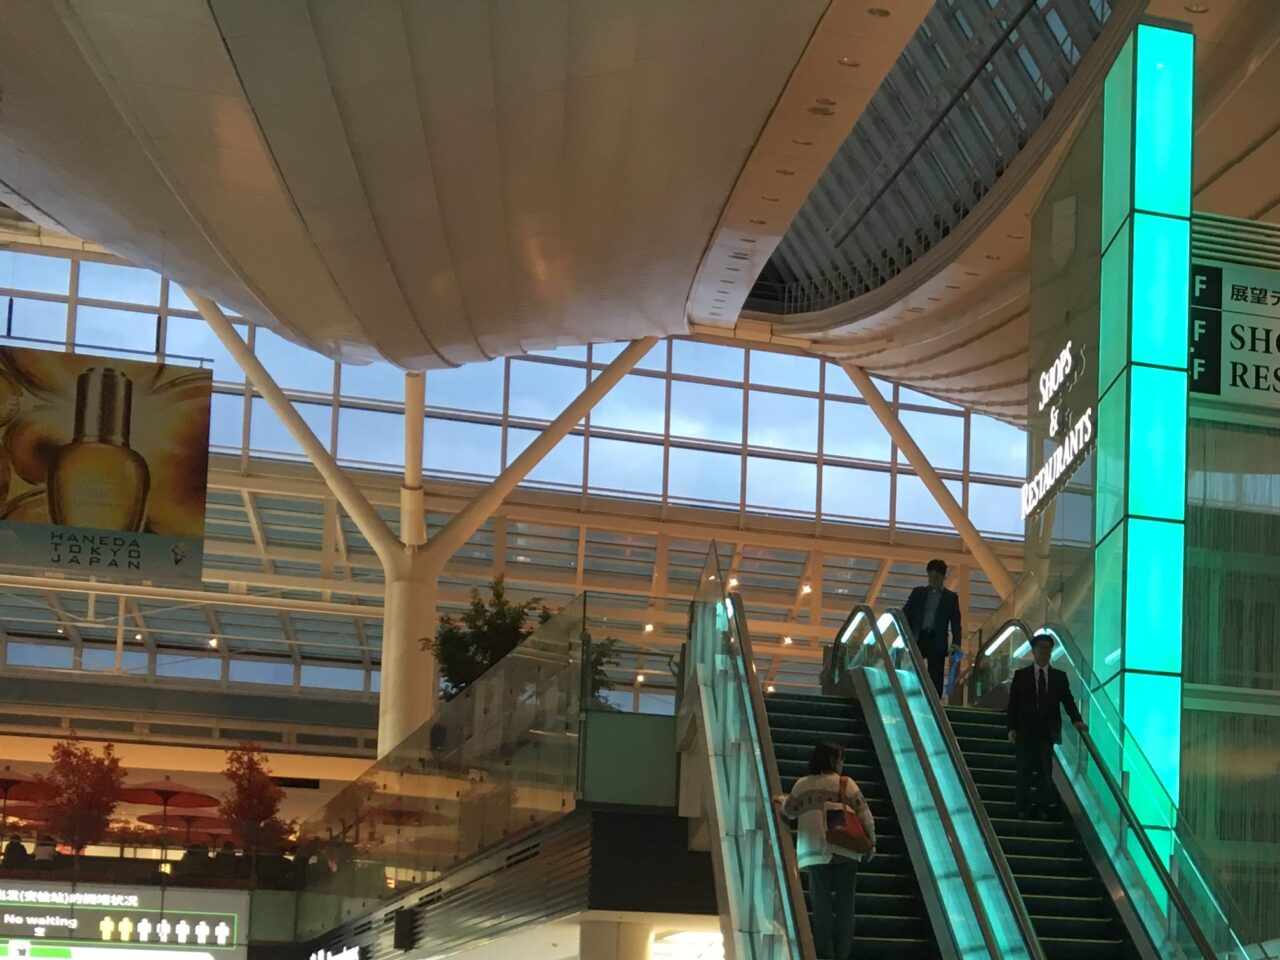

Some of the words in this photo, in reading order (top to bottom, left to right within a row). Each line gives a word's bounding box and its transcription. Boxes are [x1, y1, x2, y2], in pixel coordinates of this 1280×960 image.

[1038, 339, 1073, 412] SHOPS
[1049, 405, 1060, 438] &
[1021, 407, 1093, 522] RESTAURANTS
[51, 531, 140, 549] HANEDA
[51, 542, 140, 560] TOKYO
[51, 554, 140, 570] JAPAN
[4, 913, 25, 926] No
[26, 915, 79, 929] waiting
